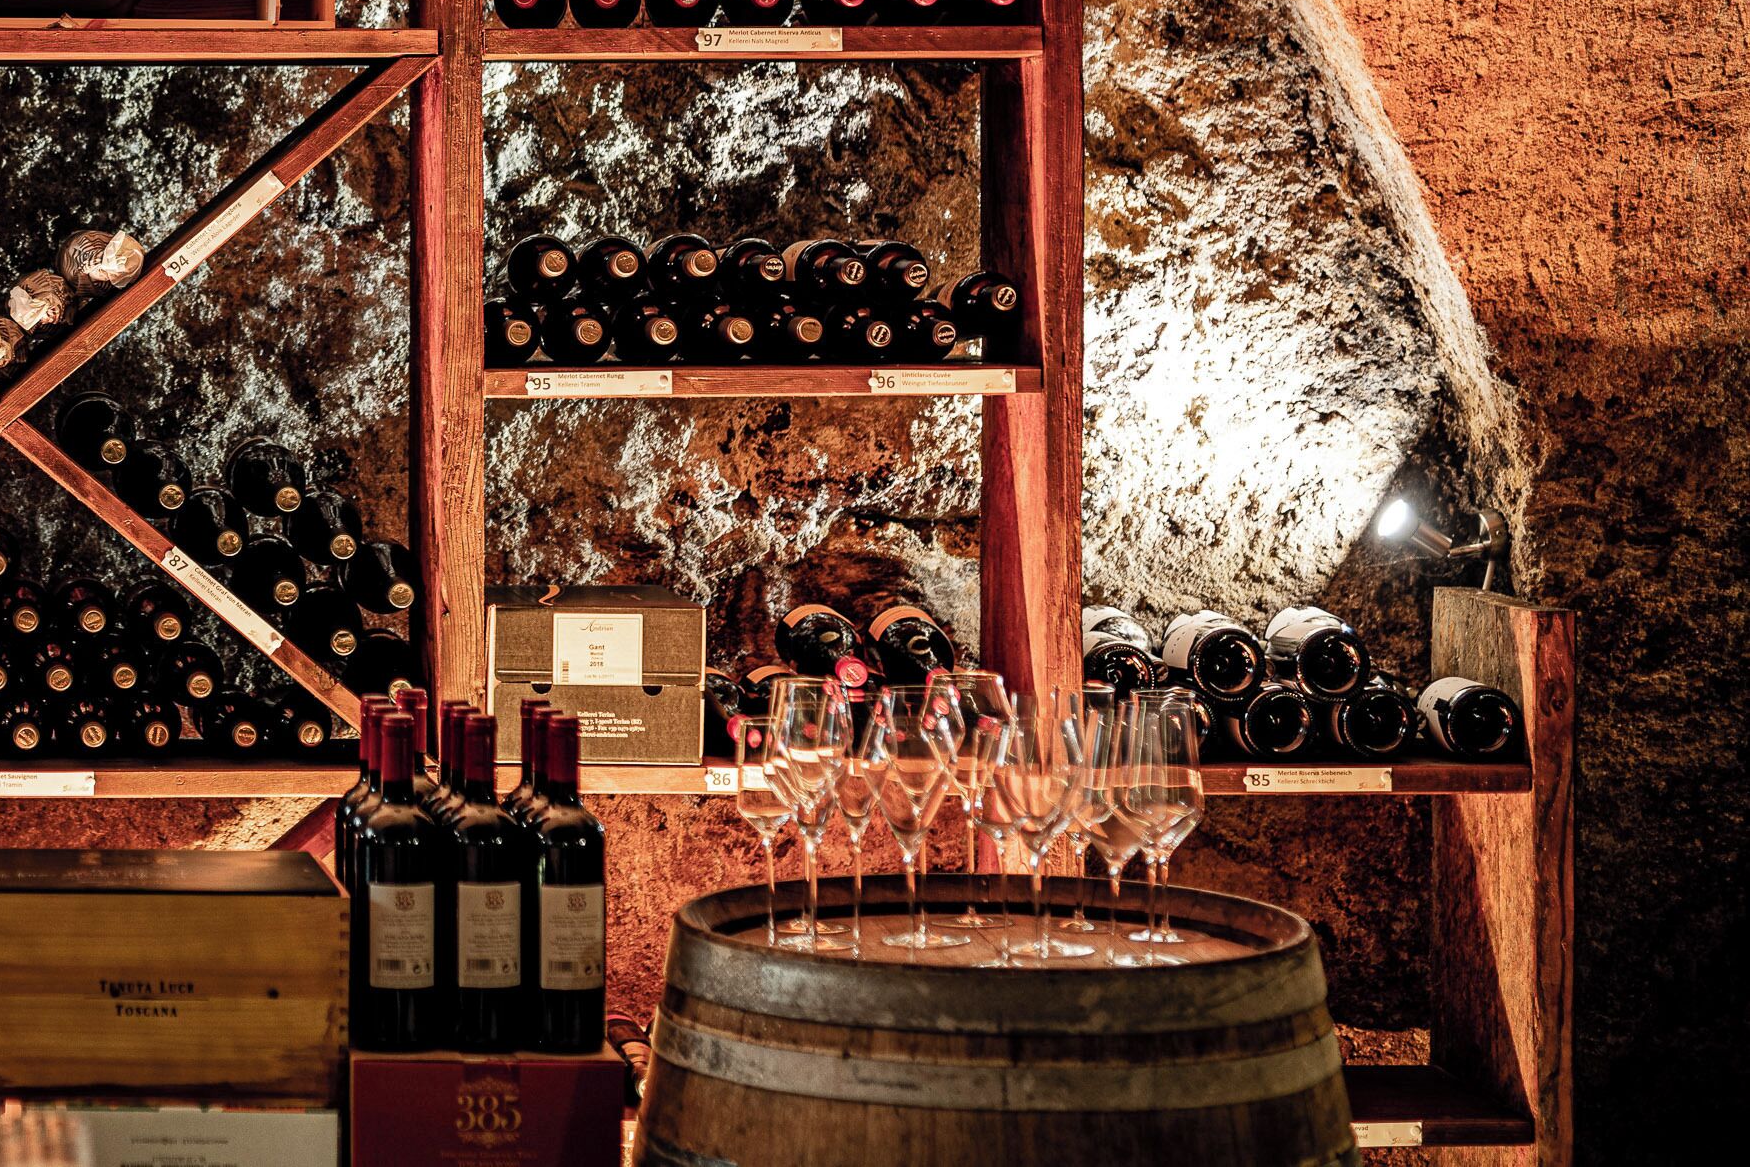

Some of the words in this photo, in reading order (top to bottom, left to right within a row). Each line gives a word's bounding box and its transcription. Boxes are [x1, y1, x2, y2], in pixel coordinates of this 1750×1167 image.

[704, 34, 722, 47] 97
[185, 230, 207, 249] Cabernet
[190, 237, 211, 255] Weingut
[210, 228, 221, 239] Alois
[221, 213, 241, 230] Lageder
[169, 254, 189, 273] 94
[534, 378, 551, 390] 95
[877, 376, 895, 389] 96
[168, 554, 188, 573] 87
[189, 573, 207, 589] Kellerei
[206, 588, 222, 602] Meran
[194, 567, 215, 586] Cabernet
[215, 584, 227, 596] Graf
[226, 595, 235, 603] von
[235, 602, 251, 616] Meran
[713, 773, 731, 786] 86
[1252, 774, 1270, 786] 85
[115, 1003, 178, 1017] TOSCANA
[456, 1095, 522, 1131] 385
